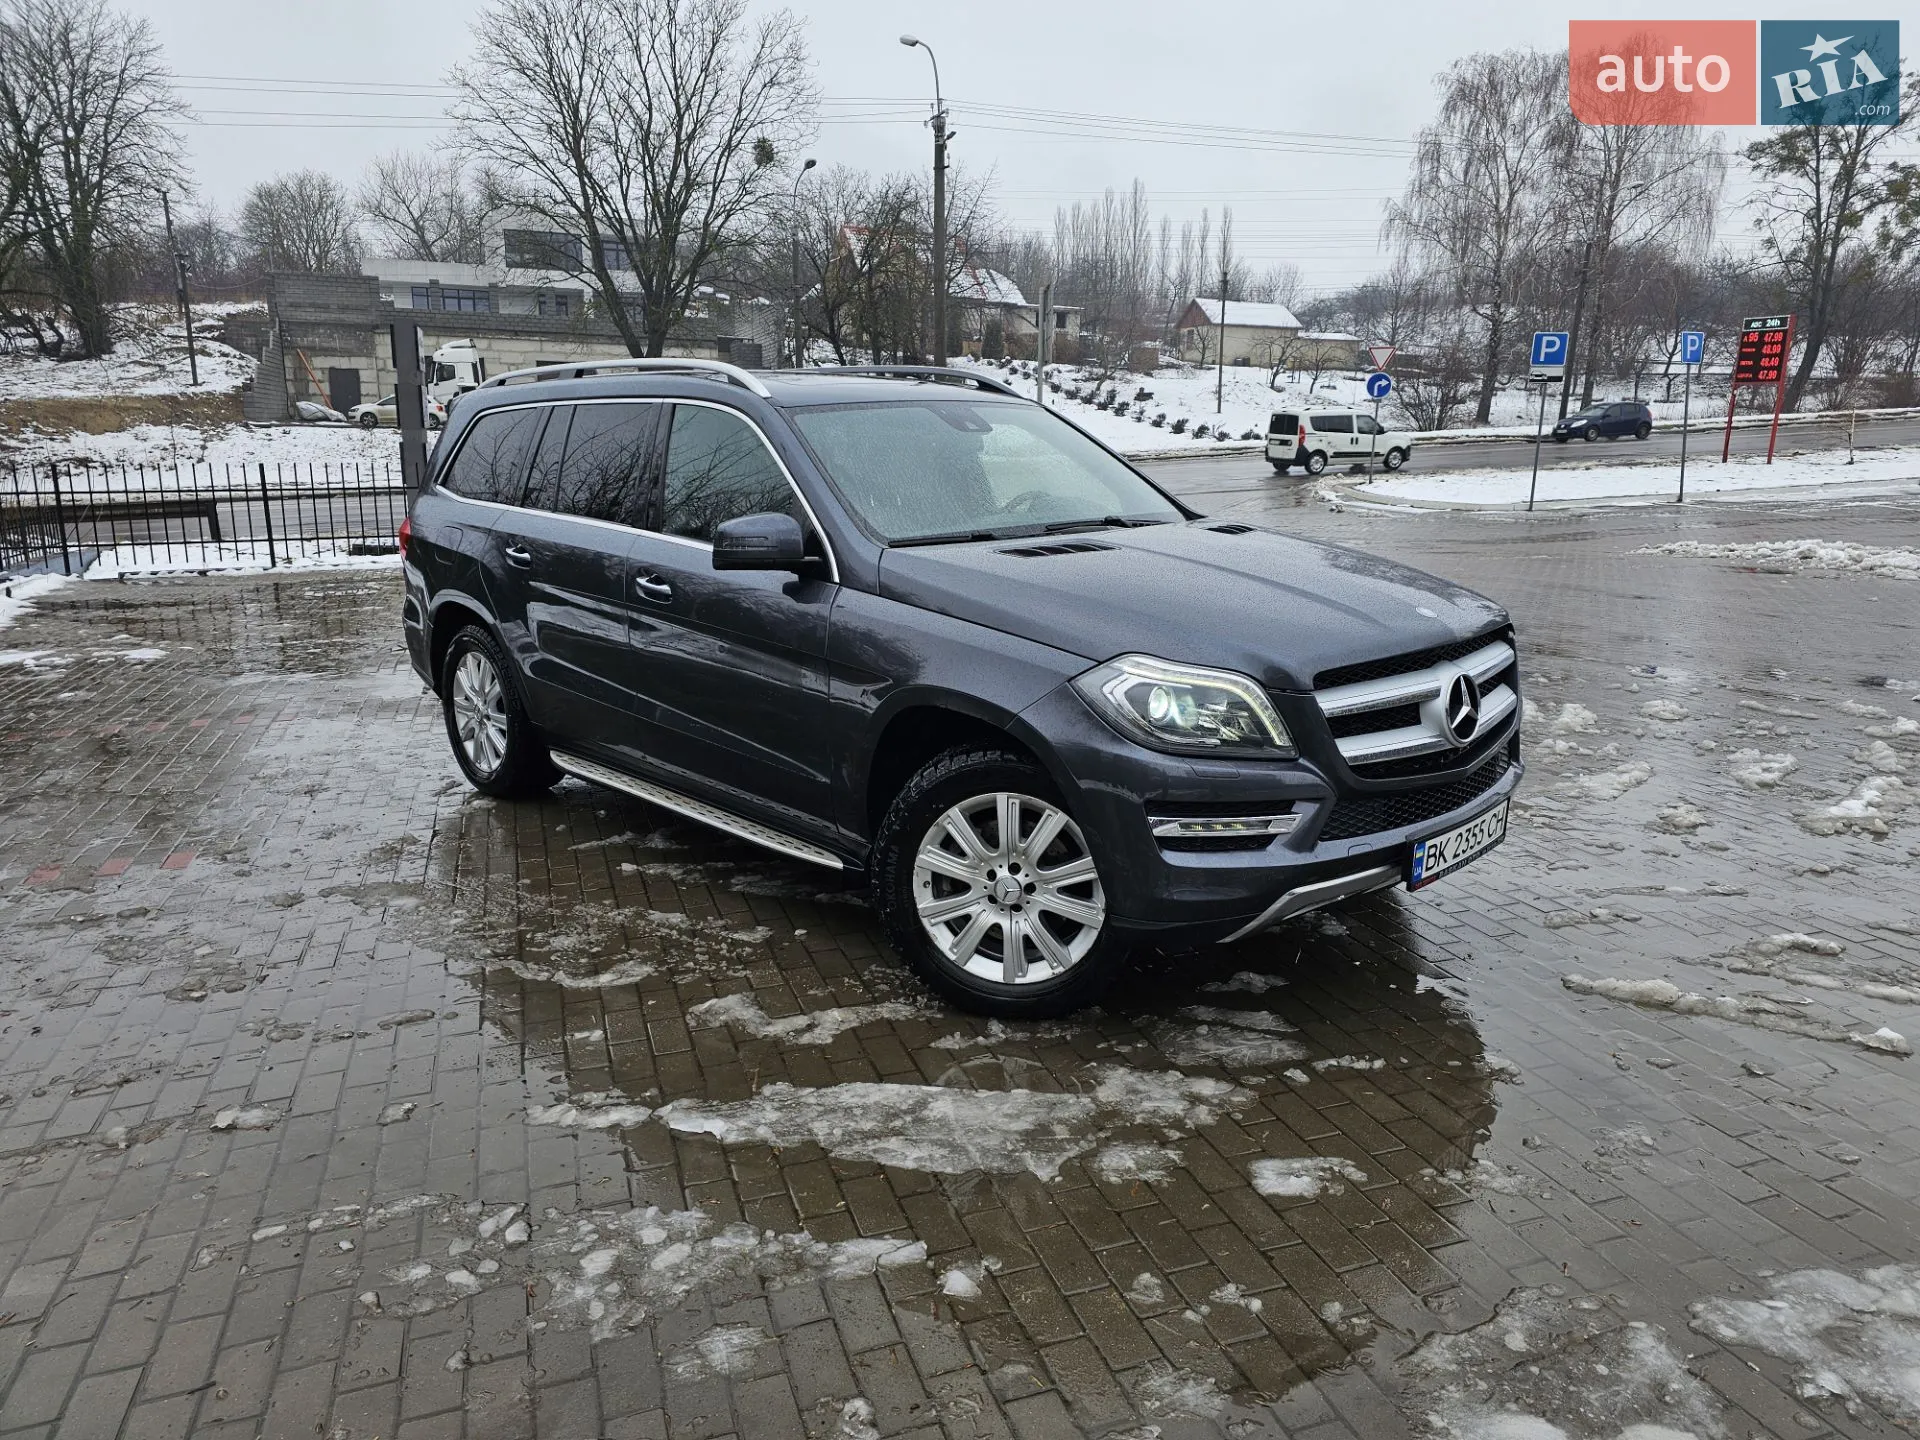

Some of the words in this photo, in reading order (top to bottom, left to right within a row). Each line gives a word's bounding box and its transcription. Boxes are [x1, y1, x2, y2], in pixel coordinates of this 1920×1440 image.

[1766, 318, 1780, 327] 24h
[1539, 336, 1561, 362] P
[1687, 335, 1699, 360] P
[1764, 332, 1783, 342] 47.99
[1758, 370, 1777, 379] 47.99
[1425, 837, 1451, 872] BK
[1452, 819, 1487, 860] 2355
[1488, 806, 1506, 839] CH
[885, 845, 900, 911] OKOHAMA
